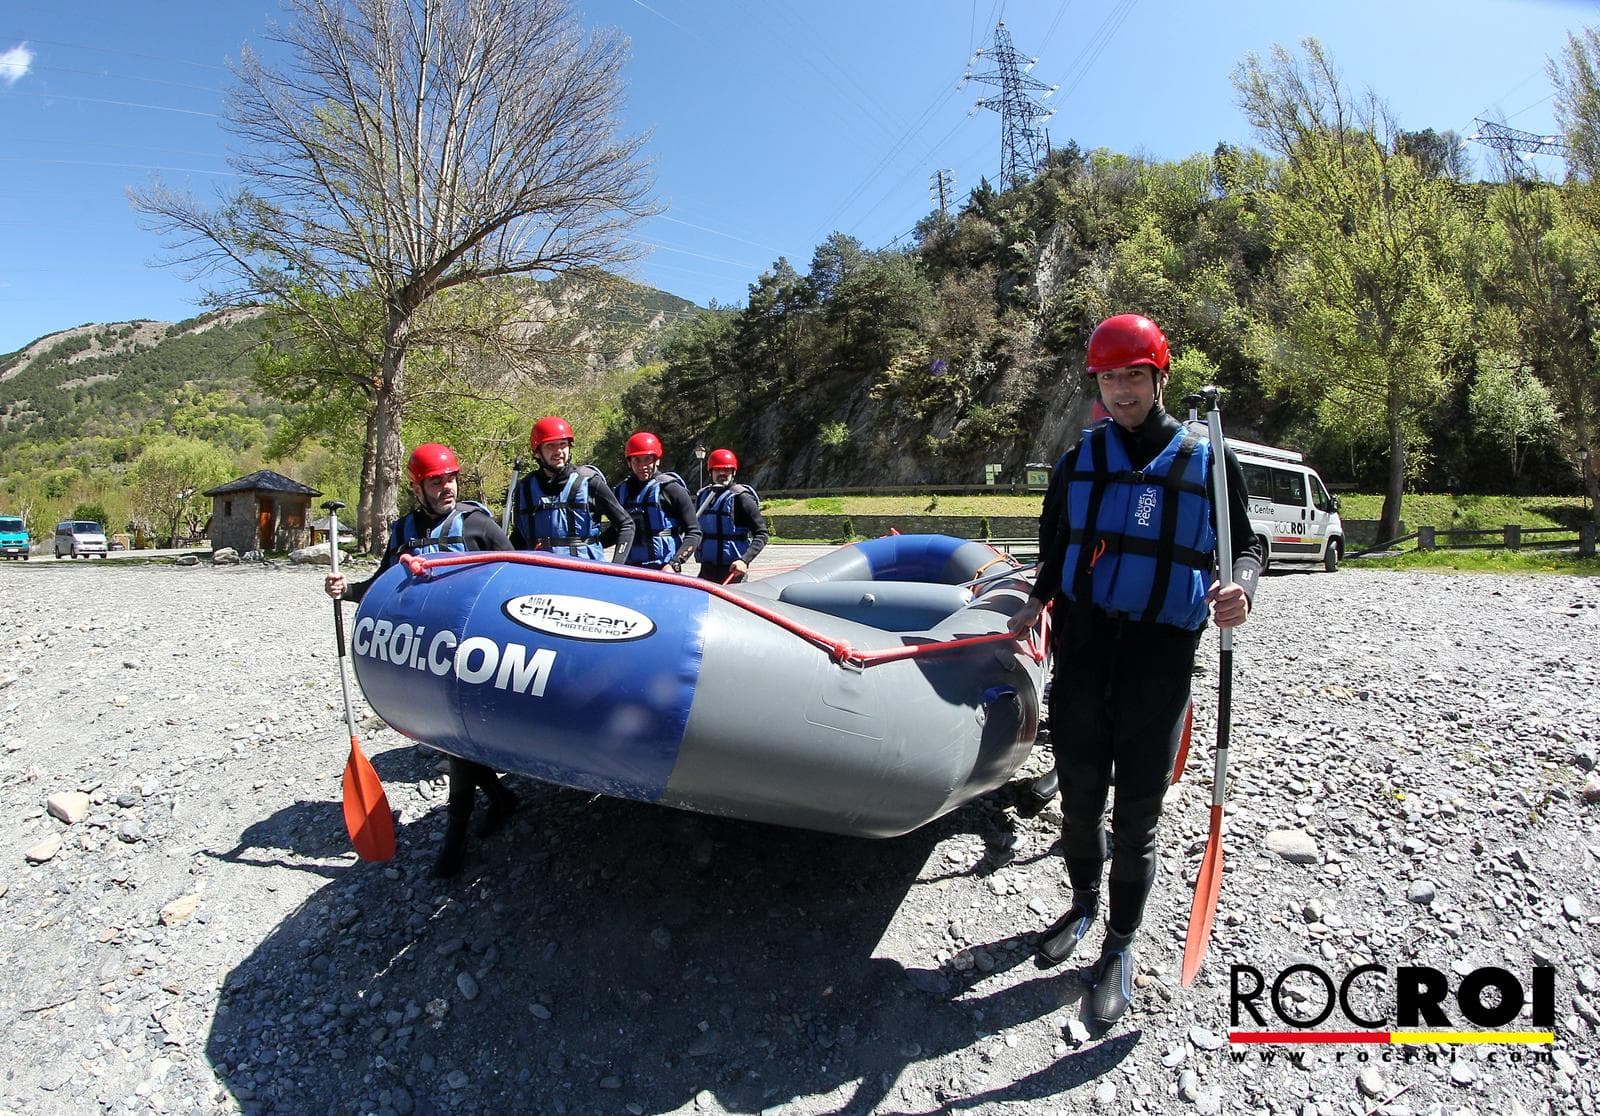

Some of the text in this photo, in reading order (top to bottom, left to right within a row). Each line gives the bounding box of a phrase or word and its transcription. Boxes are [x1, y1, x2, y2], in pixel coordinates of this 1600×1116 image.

[1254, 504, 1275, 515] Centre
[519, 598, 638, 635] tributary
[555, 621, 602, 634] THIRTEEN
